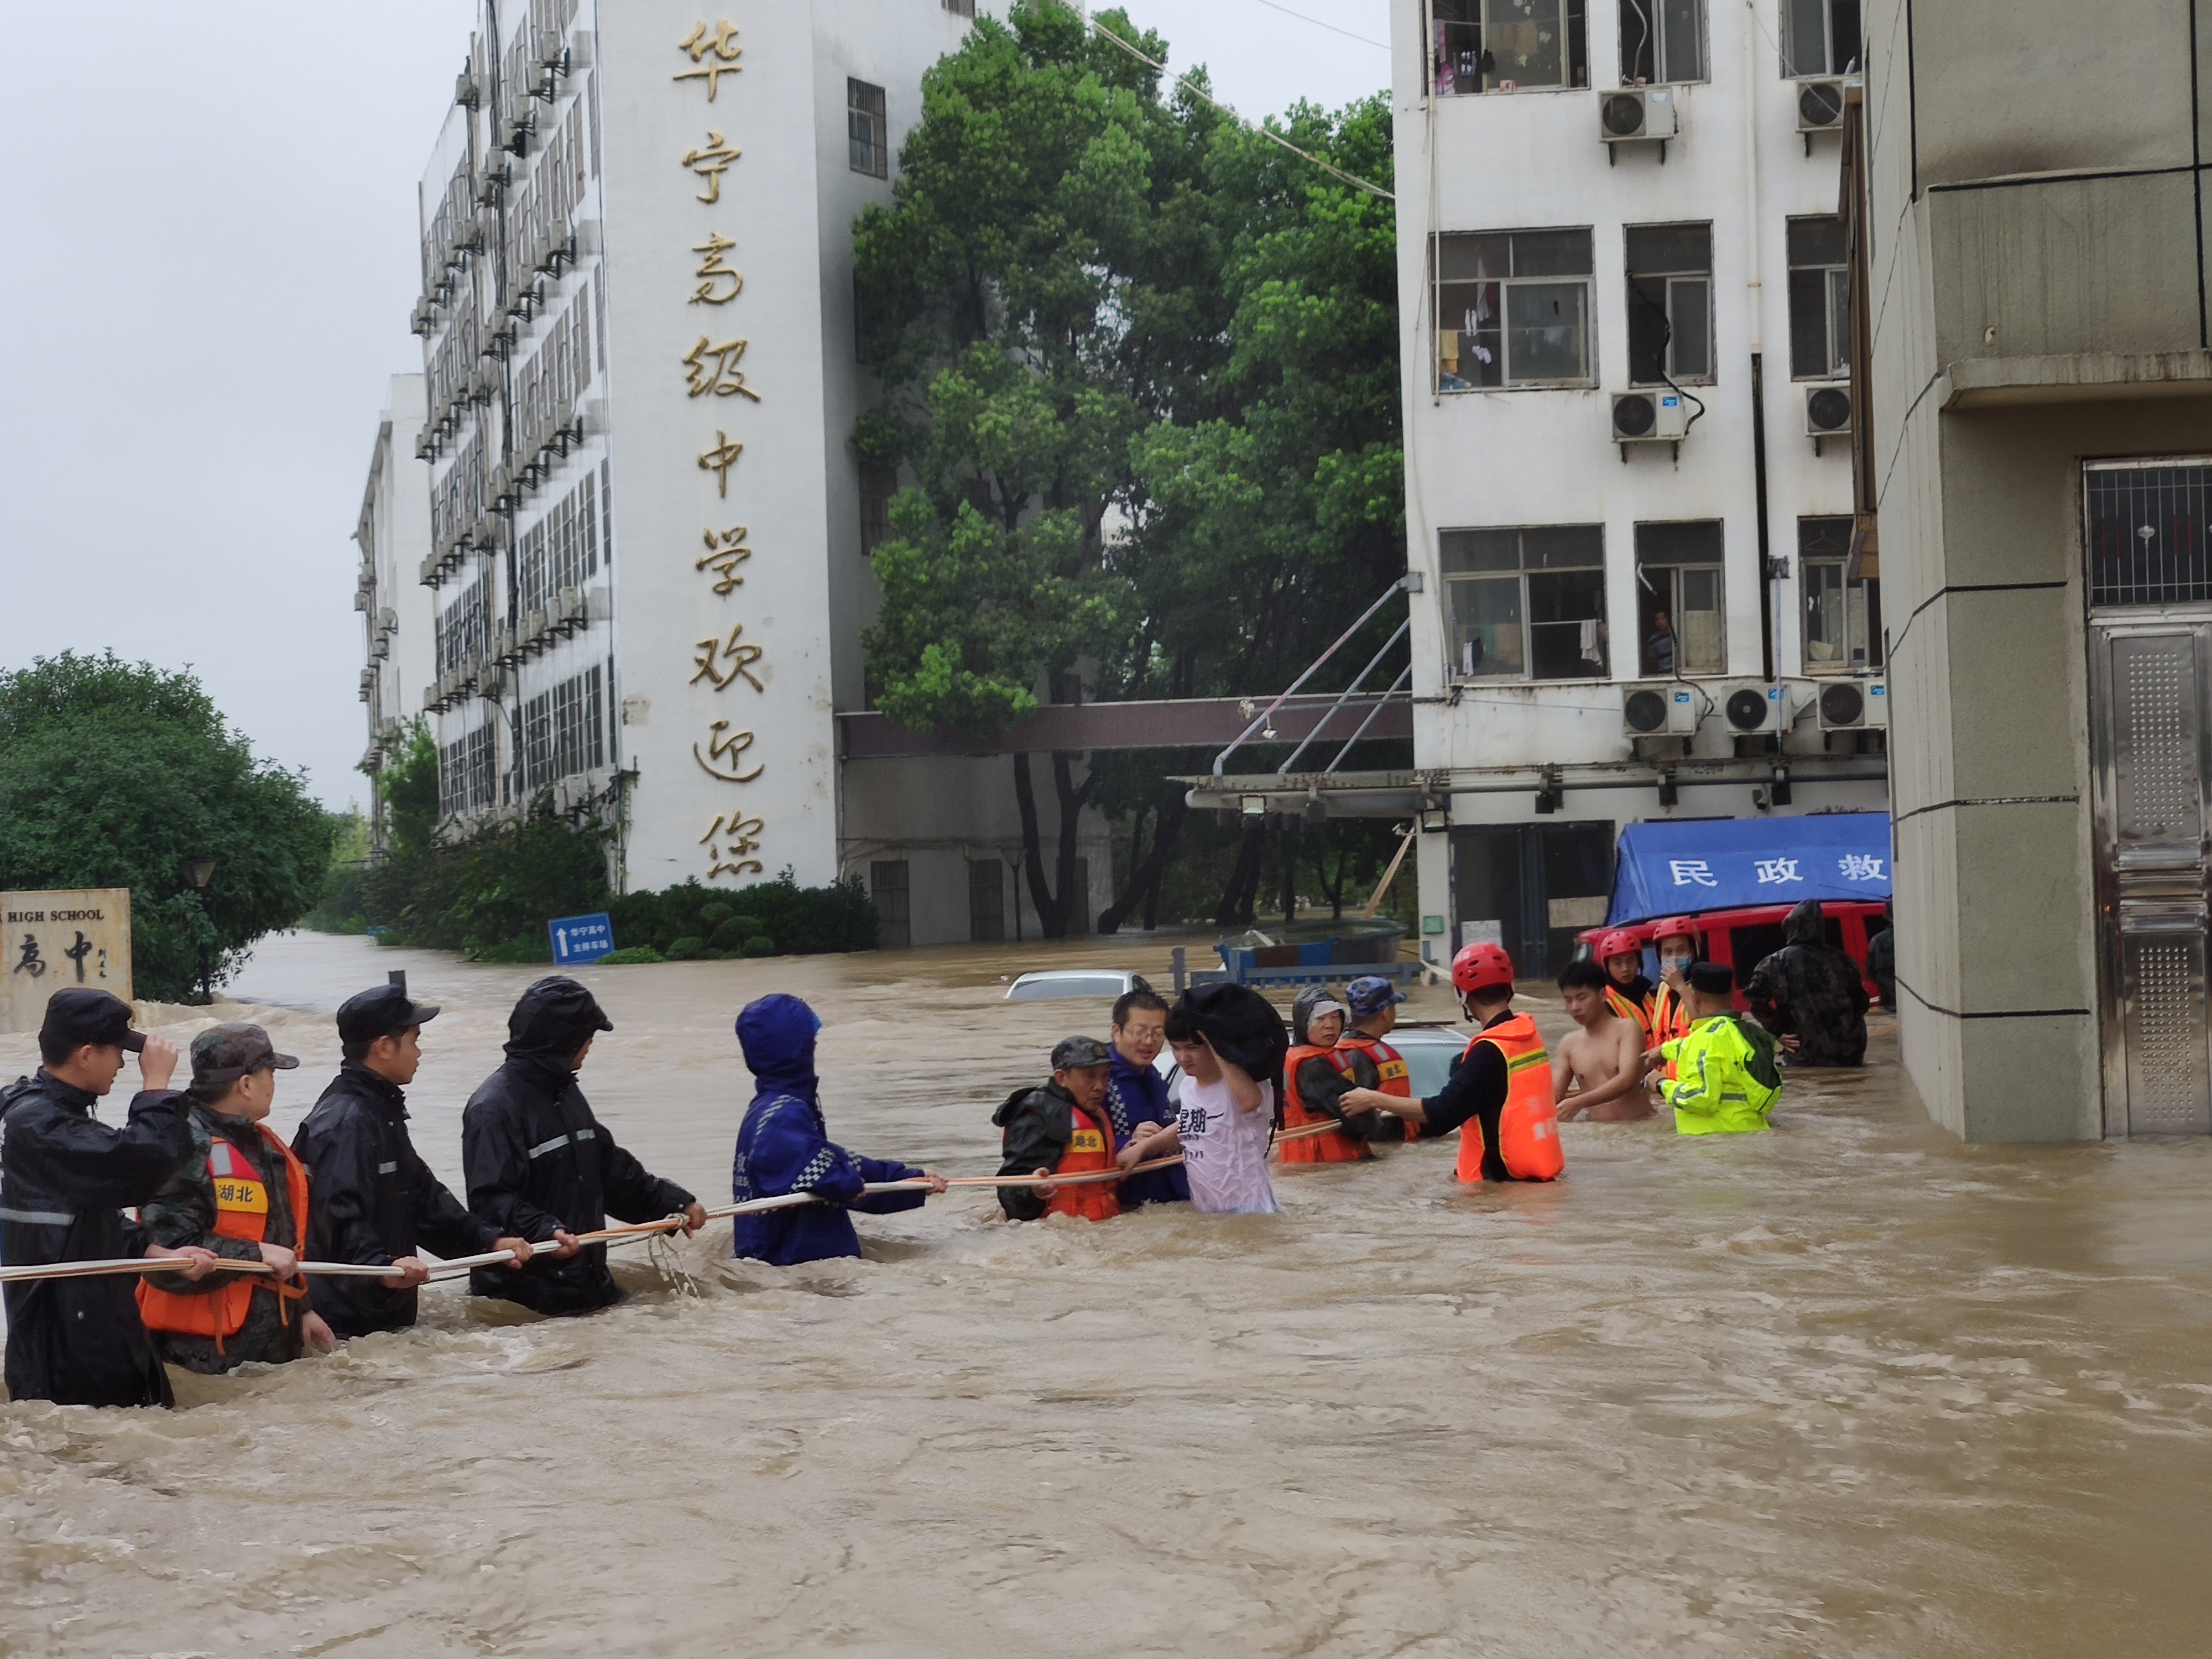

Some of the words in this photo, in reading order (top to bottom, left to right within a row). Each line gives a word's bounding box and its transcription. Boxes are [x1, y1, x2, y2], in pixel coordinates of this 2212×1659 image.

[672, 19, 765, 880] 华宁高级中学欢迎您
[1668, 853, 1888, 888] 民政救
[7, 911, 45, 922] HIGH
[50, 909, 105, 921] SCHOOL
[570, 925, 606, 937] 华宁高中
[573, 940, 608, 952] 主停车场
[13, 931, 93, 983] 高中
[1177, 1108, 1224, 1133] 星期一
[218, 1185, 253, 1202] 湖北
